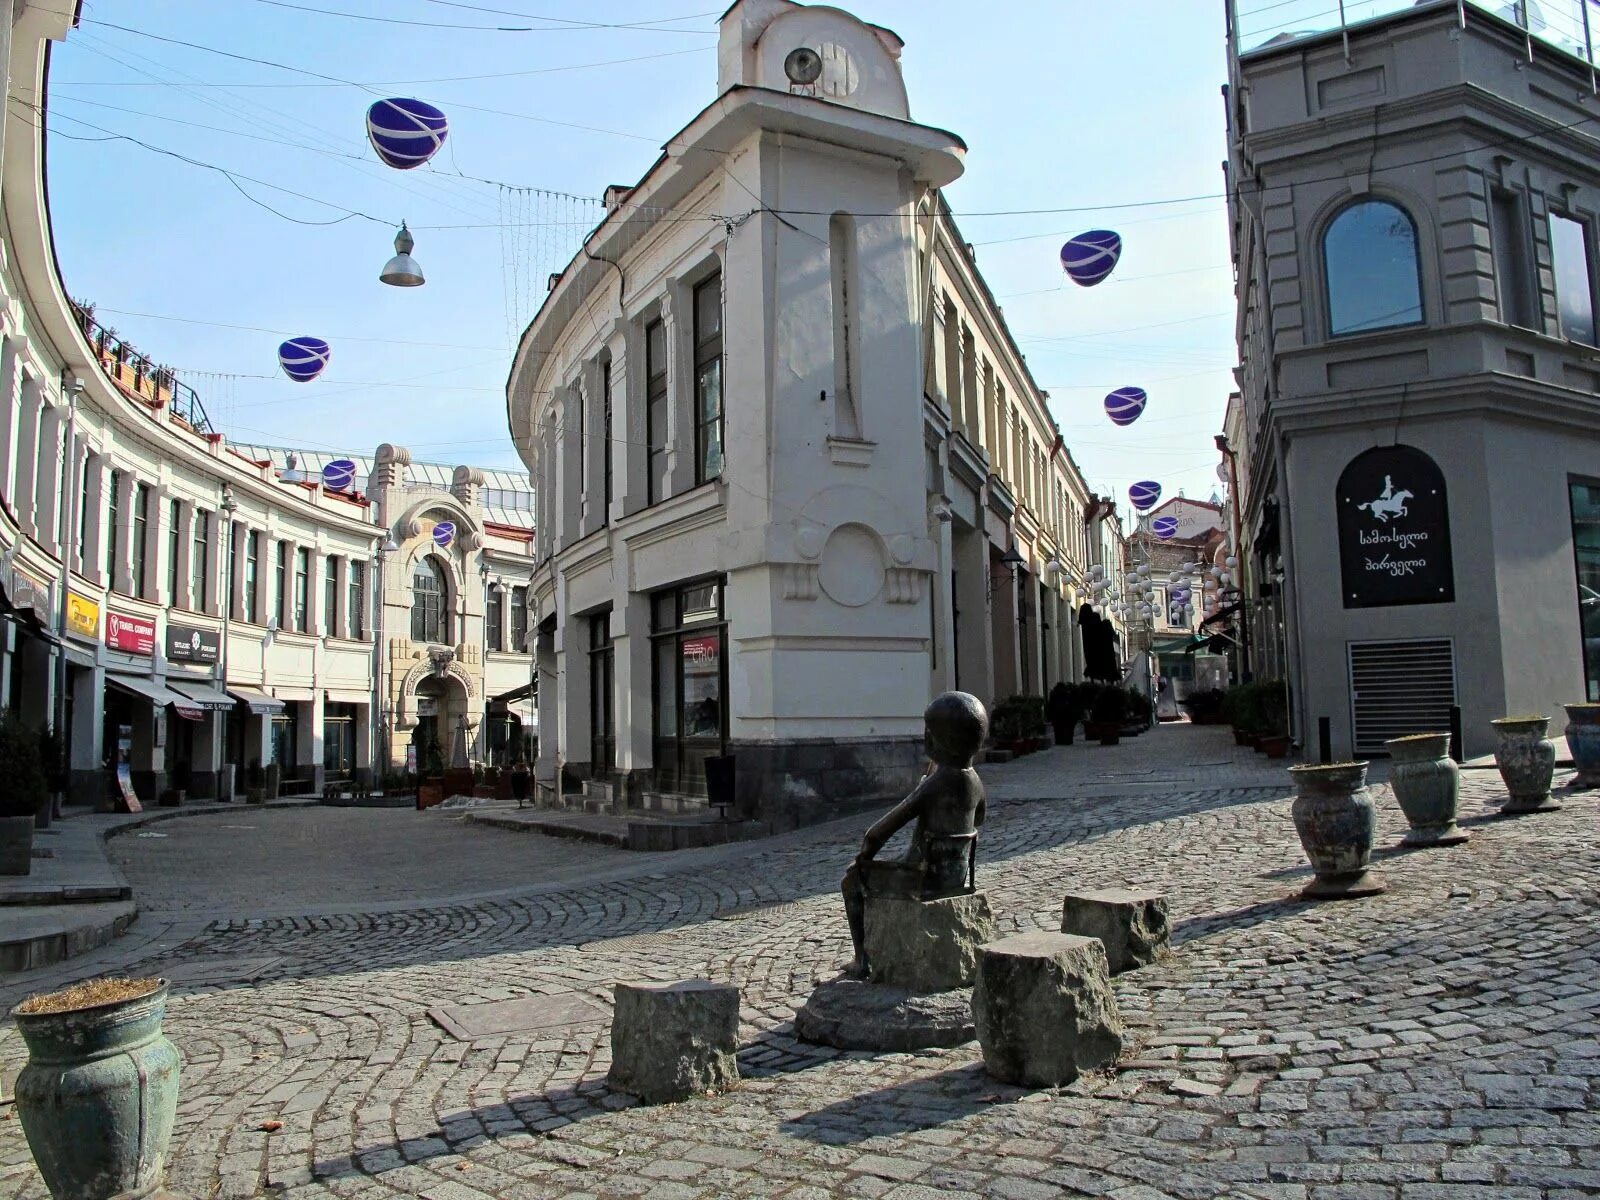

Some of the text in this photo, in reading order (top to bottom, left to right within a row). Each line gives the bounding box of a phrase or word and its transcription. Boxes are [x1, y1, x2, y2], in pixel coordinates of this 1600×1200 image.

[1359, 527, 1429, 550] სამოსელი
[1364, 553, 1427, 577] პირველი
[118, 620, 154, 637] TRAVEL COMPANY
